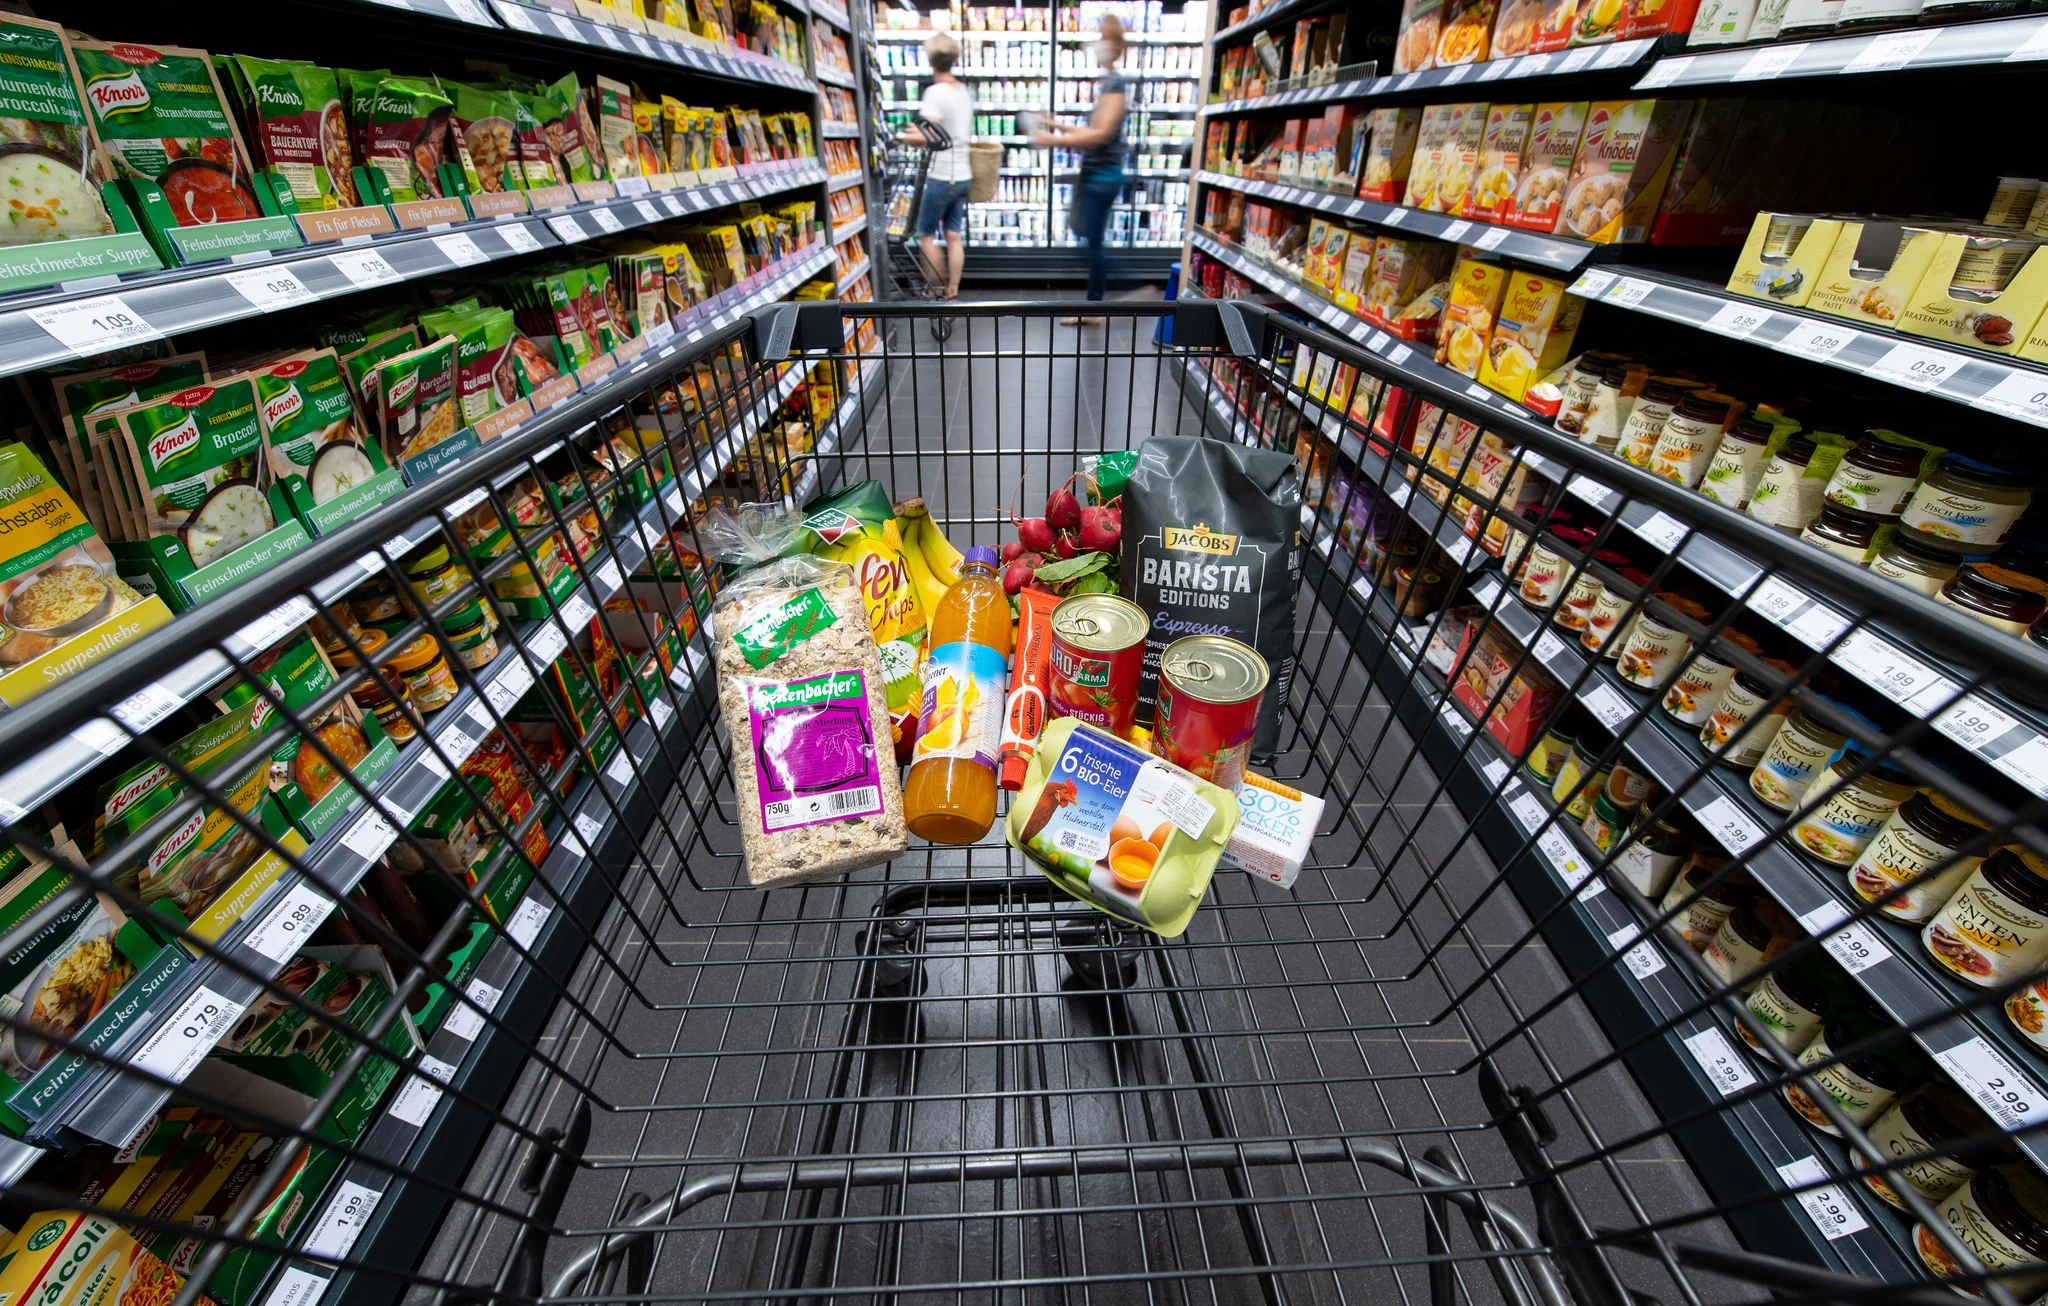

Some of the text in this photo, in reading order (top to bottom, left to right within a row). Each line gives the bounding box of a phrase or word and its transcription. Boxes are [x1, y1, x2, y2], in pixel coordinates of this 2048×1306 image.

[91, 81, 147, 108] Knorr
[258, 83, 303, 107] Knorr
[377, 97, 414, 116] Knorr
[155, 107, 224, 120] Strauchtomaten
[270, 136, 319, 150] BAUERNTOPF
[1495, 136, 1522, 153] Knödel
[1555, 128, 1579, 139] Semmel
[1613, 129, 1643, 141] Semmel
[1542, 138, 1576, 157] Knödel
[1597, 141, 1639, 161] Knödel
[407, 203, 458, 222] Fix für Fleisch
[315, 214, 381, 236] Fix für Fleisch
[181, 226, 293, 254] Feinschmecker Suppe
[0, 247, 151, 280] einschmecker Suppe
[361, 260, 384, 274] 0.79
[267, 278, 297, 296] 0.99
[1812, 289, 1862, 307] KRUSTENTIER-
[1512, 289, 1547, 313] Kartoffel
[1823, 300, 1844, 312] PASTE
[92, 313, 134, 331] 1.09
[1514, 308, 1539, 325] Püree
[1732, 314, 1758, 328] 0.99
[1904, 309, 1966, 330] BRATEN-PASTE
[458, 340, 487, 358] Knorr
[1810, 335, 1840, 350] 0.99
[1910, 360, 1947, 377] 0.99
[392, 375, 418, 399] Knorr
[264, 394, 301, 420] Knorr
[212, 420, 258, 449] Broccoli
[1666, 417, 1707, 436] Lacroix
[151, 425, 198, 460] Knorr
[1659, 444, 1685, 459] FOND
[415, 438, 469, 474] Fix für Gemüse
[1841, 465, 1876, 482] Lacroix
[1855, 481, 1881, 494] FOND
[317, 475, 400, 528] Feinschmecker Suppe
[1924, 501, 1987, 526] FISCH FOND
[1936, 495, 1986, 513] Lacroix
[45, 510, 72, 530] Suppe
[6, 560, 20, 574] mit
[20, 552, 42, 569] vielen
[72, 527, 86, 542] A-Z
[1169, 532, 1230, 551] JACOBS
[193, 528, 305, 598] Feinschmecker Suppe
[1873, 561, 1906, 579] Lacroix
[1143, 557, 1251, 594] BARISTA
[1159, 588, 1230, 610] EDITIONS
[1763, 591, 1790, 610] 1.99
[869, 595, 914, 632] Chips
[1152, 611, 1232, 637] Espresso
[43, 619, 142, 682] Suppenliebe
[1143, 670, 1158, 681] FLAT
[1882, 664, 1915, 688] 1.99
[1069, 707, 1105, 723] STÜCKIG
[1606, 707, 1624, 722] 2.99
[1952, 708, 1990, 735] 1.99
[449, 732, 468, 752] 1.79
[1780, 729, 1827, 757] Lacroix
[369, 746, 394, 772] Suppe
[1060, 747, 1084, 774] 6
[1082, 752, 1122, 781] frische
[1768, 752, 1800, 777] FOND
[1771, 738, 1813, 774] FISCH
[108, 765, 170, 816] Knorr
[1076, 764, 1128, 800] BIO-Eier
[766, 802, 790, 816] 750g
[1078, 806, 1105, 821] mobilen
[1239, 784, 1304, 828] 30%
[1825, 797, 1884, 829] FISCH
[1062, 810, 1107, 834] Hühnerstall
[1723, 820, 1749, 844] 2.99
[1823, 811, 1868, 835] FOND
[150, 814, 203, 868] Knorr
[1550, 840, 1568, 857] 0.59
[1890, 824, 1947, 862] Lacroix
[1878, 834, 1937, 882] ENTE
[213, 853, 284, 927] Suppenliebe
[504, 873, 523, 901] Soße
[282, 903, 311, 932] 0.89
[1970, 883, 2044, 930] Lacroix
[1955, 912, 2003, 948] FOND
[1956, 892, 2030, 948] ENTEN
[1837, 931, 1870, 959] 2.99
[1631, 947, 1652, 969] 2.99
[31, 995, 141, 1108] Feinscmecker
[140, 955, 182, 999] Sauce
[145, 1020, 176, 1054] CHAMPIGNON
[175, 1004, 190, 1024] RAHM
[188, 992, 205, 1010] SAUCE
[182, 1003, 219, 1039] 0.79
[1715, 1056, 1740, 1083] 2.99
[1986, 1077, 2031, 1114] 2.99
[2016, 1078, 2036, 1096] 400ML
[276, 1193, 304, 1239] Knorr
[337, 1194, 363, 1229] 1.99
[1816, 1192, 1847, 1225] 2.99
[1960, 1199, 2030, 1264] Lacroix
